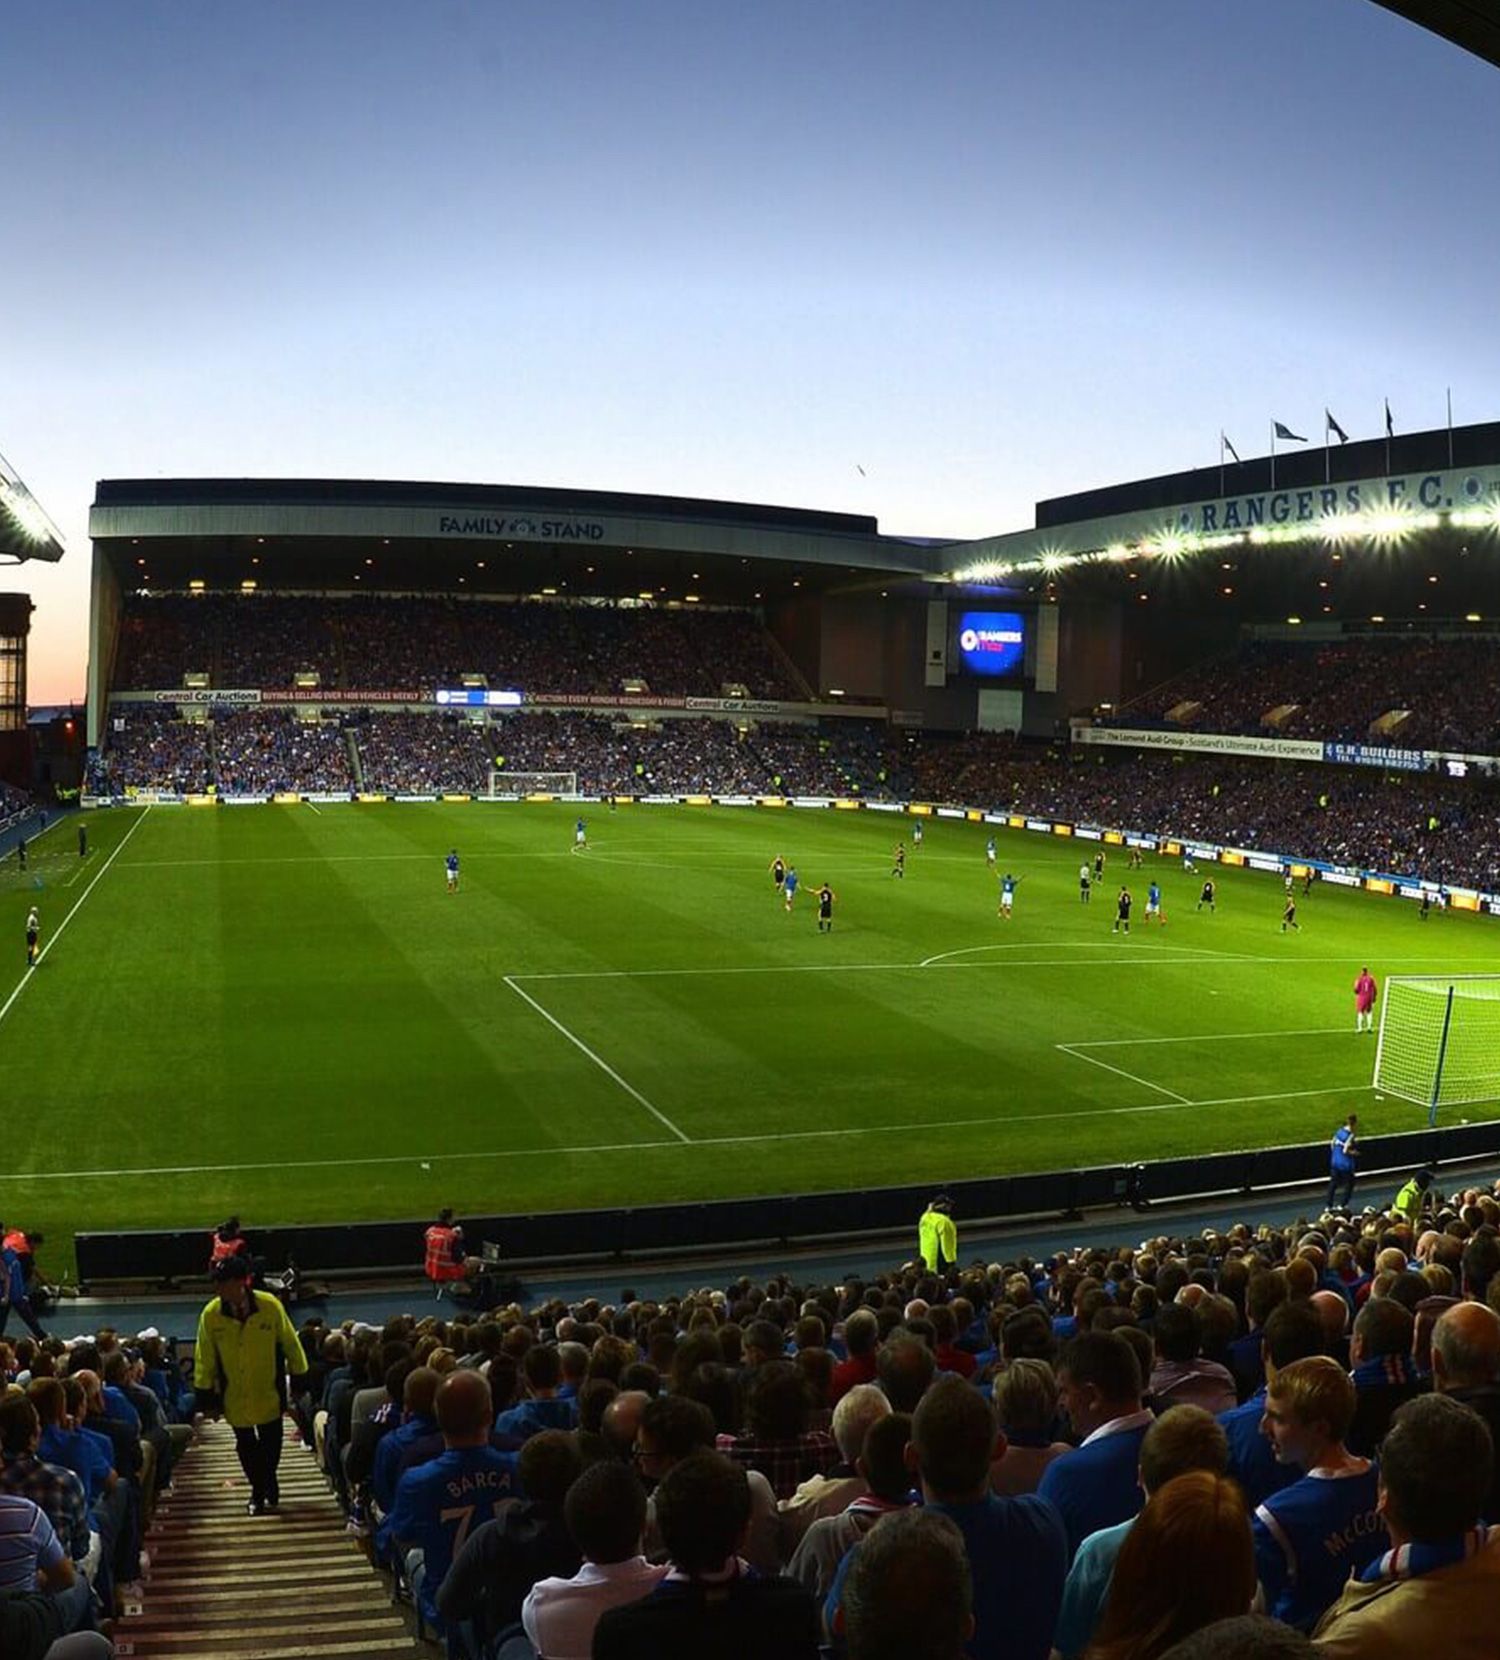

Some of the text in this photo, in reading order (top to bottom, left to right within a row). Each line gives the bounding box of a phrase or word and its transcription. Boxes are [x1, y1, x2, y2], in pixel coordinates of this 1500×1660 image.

[1202, 485, 1360, 532] RANGERS
[440, 517, 604, 540] FAMILY STAND
[156, 691, 258, 701] Central Car Auctions
[688, 698, 778, 711] Central Car Auctions
[1147, 735, 1162, 743] Audi
[1163, 735, 1184, 746] Group
[1259, 741, 1276, 752] Audi
[1279, 743, 1320, 755] Experience
[1360, 746, 1421, 761] BUILDERS
[446, 1471, 512, 1498] BARCA
